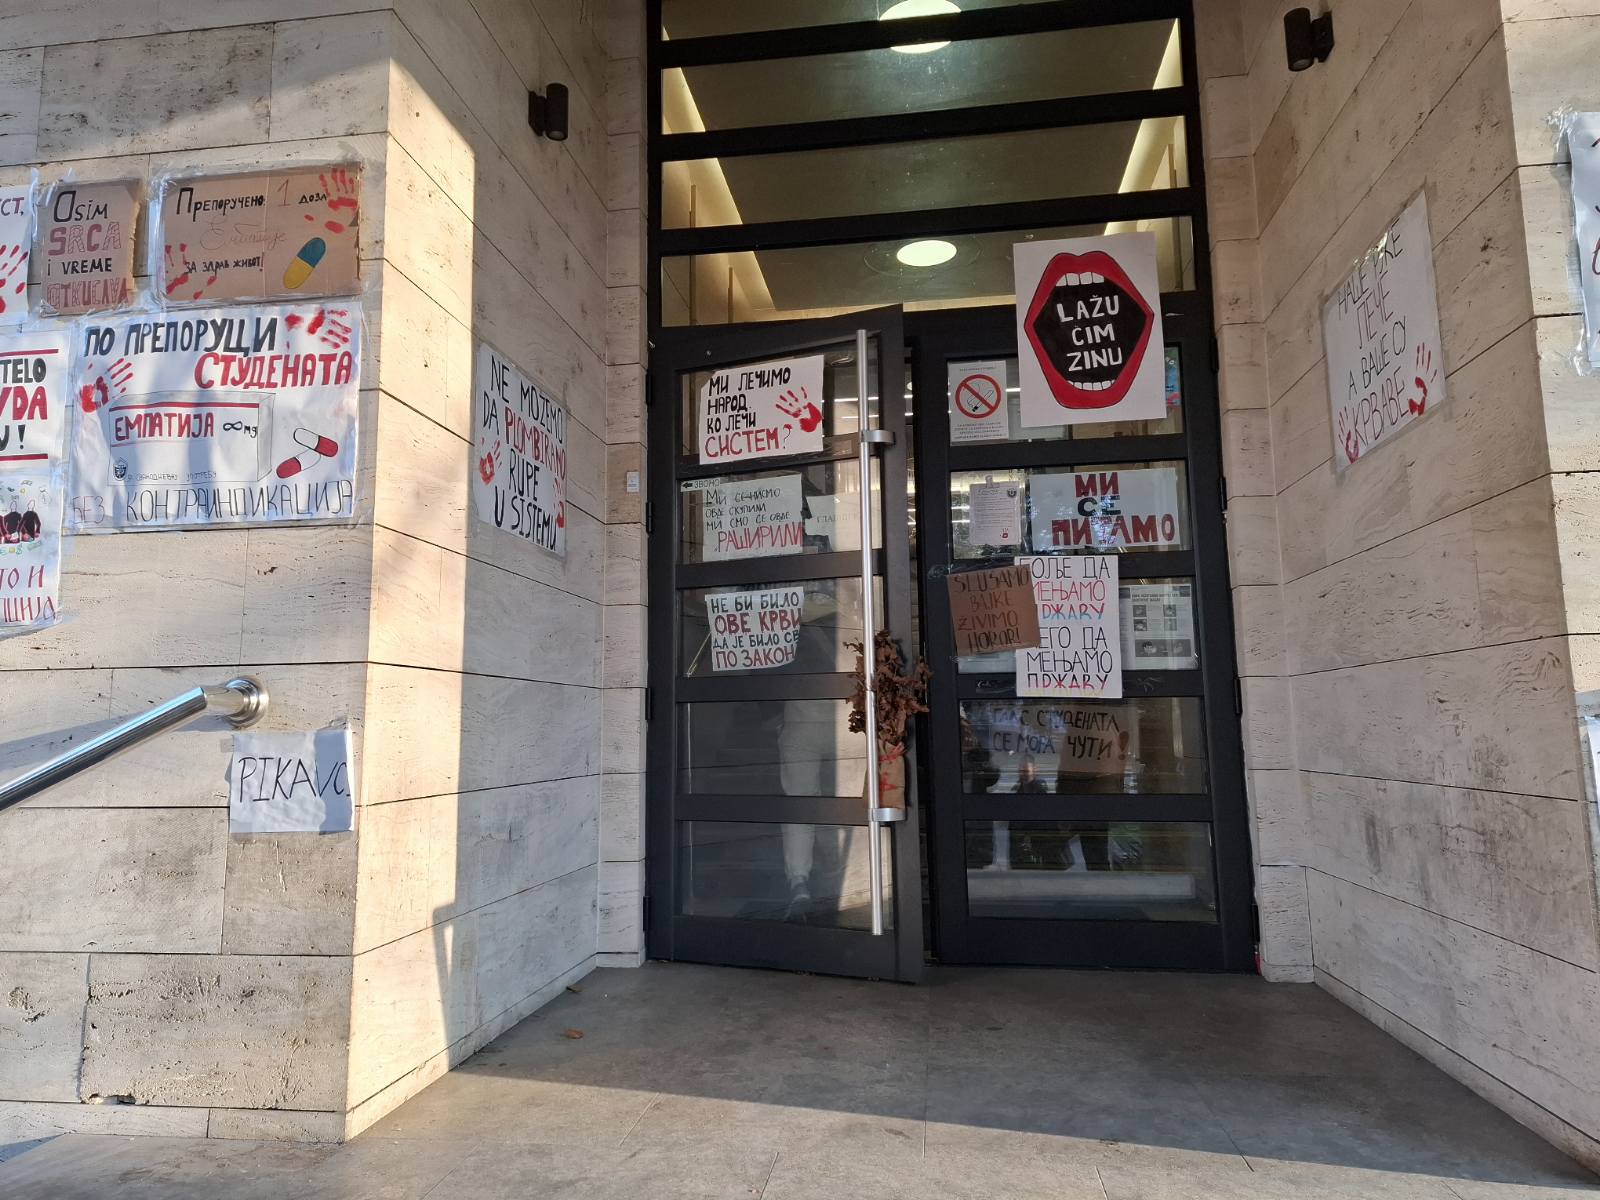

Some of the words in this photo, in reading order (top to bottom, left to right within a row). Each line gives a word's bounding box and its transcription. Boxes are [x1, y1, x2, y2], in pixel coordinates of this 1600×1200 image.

[276, 179, 291, 208] 1
[47, 221, 122, 256] SRCA
[62, 258, 113, 274] VREME
[1056, 294, 1120, 323] LAŽU
[85, 327, 115, 356] ПО
[124, 317, 278, 356] ПРЕПОРУЦИ
[194, 350, 353, 389] СТУДЕНАТА
[1066, 347, 1123, 372] ZINU
[1348, 370, 1358, 396] А
[1392, 315, 1406, 356] СУ
[491, 355, 509, 403] NE
[708, 375, 729, 396] МИ
[737, 366, 791, 392] ЛЕЧИМО
[1351, 366, 1410, 447] КРВАВЕ
[115, 412, 215, 441] ЕМПАТИЈА
[483, 391, 500, 435] DA
[504, 406, 566, 480] PLOMBIRAMO
[706, 417, 721, 434] КО
[725, 411, 756, 431] ЛЕЧИ
[704, 423, 793, 458] СИСТЕМ?
[508, 448, 540, 501] RUPE
[1074, 471, 1120, 498] МИ
[72, 495, 105, 524] БЕЗ
[126, 480, 354, 522] КОНТРАИНДИКАЦИЈА
[1077, 495, 1122, 517] СЕ
[494, 485, 505, 528] U
[511, 495, 557, 551] SISTEMU
[729, 516, 749, 529] СМО
[717, 521, 804, 553] РАШИРИЛИ
[1082, 556, 1111, 581] ДА
[710, 597, 729, 614] НЕ
[735, 595, 753, 612] БИ
[760, 592, 799, 609] БИЛО
[714, 612, 752, 636] ОВЕ
[758, 607, 802, 633] КРВИ
[713, 637, 729, 650] ДА
[732, 635, 745, 649] ЈЕ
[749, 633, 780, 648] БИЛО
[1082, 626, 1108, 651] ДА
[715, 650, 738, 669] ПО
[1026, 650, 1113, 674] МЕЊАМО
[993, 731, 1014, 753] СЕ
